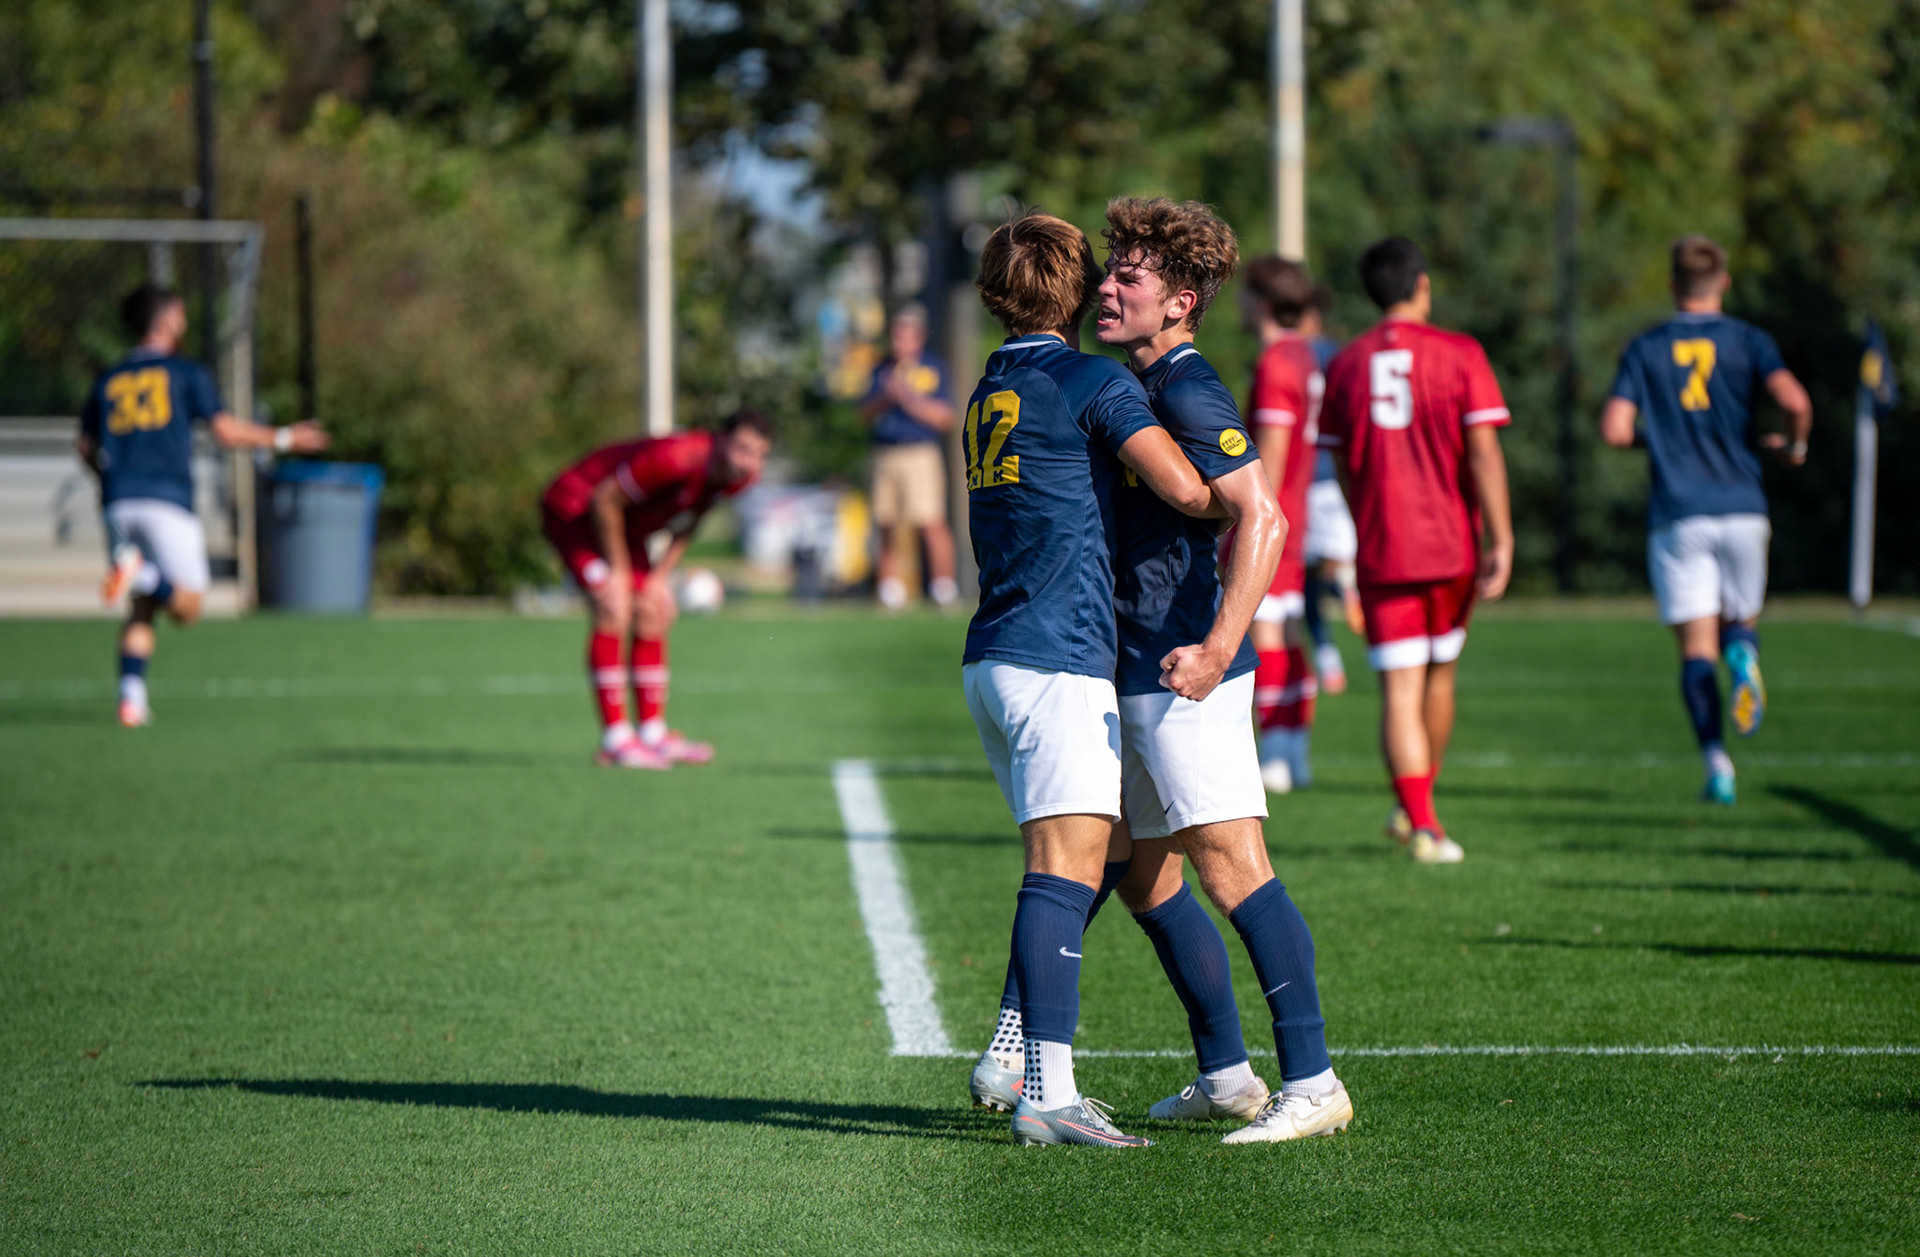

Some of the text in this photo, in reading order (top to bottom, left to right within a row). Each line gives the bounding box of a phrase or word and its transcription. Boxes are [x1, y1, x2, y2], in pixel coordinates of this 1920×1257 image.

[105, 366, 171, 435] 33
[1369, 348, 1414, 430] 5
[1672, 337, 1717, 412] 7
[966, 390, 1020, 490] 12
